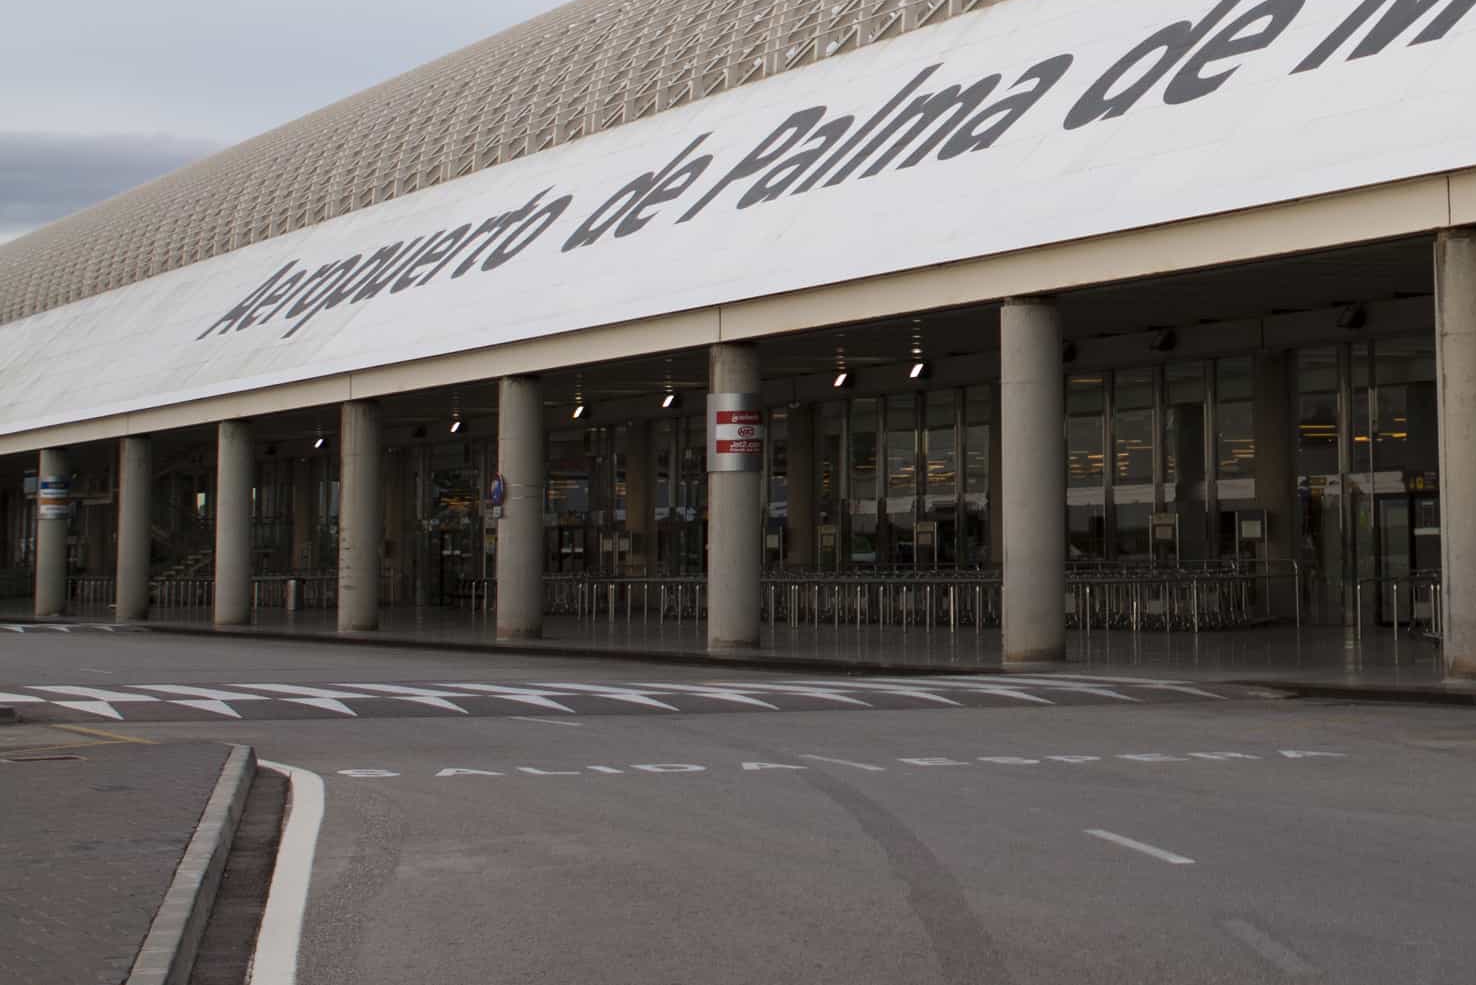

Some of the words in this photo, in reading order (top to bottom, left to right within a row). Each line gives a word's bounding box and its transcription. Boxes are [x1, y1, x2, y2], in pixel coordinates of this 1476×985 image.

[196, 185, 574, 342] Aeropuerto
[561, 132, 714, 253] de
[674, 54, 1074, 225] Palma
[336, 761, 808, 778] SALIDA
